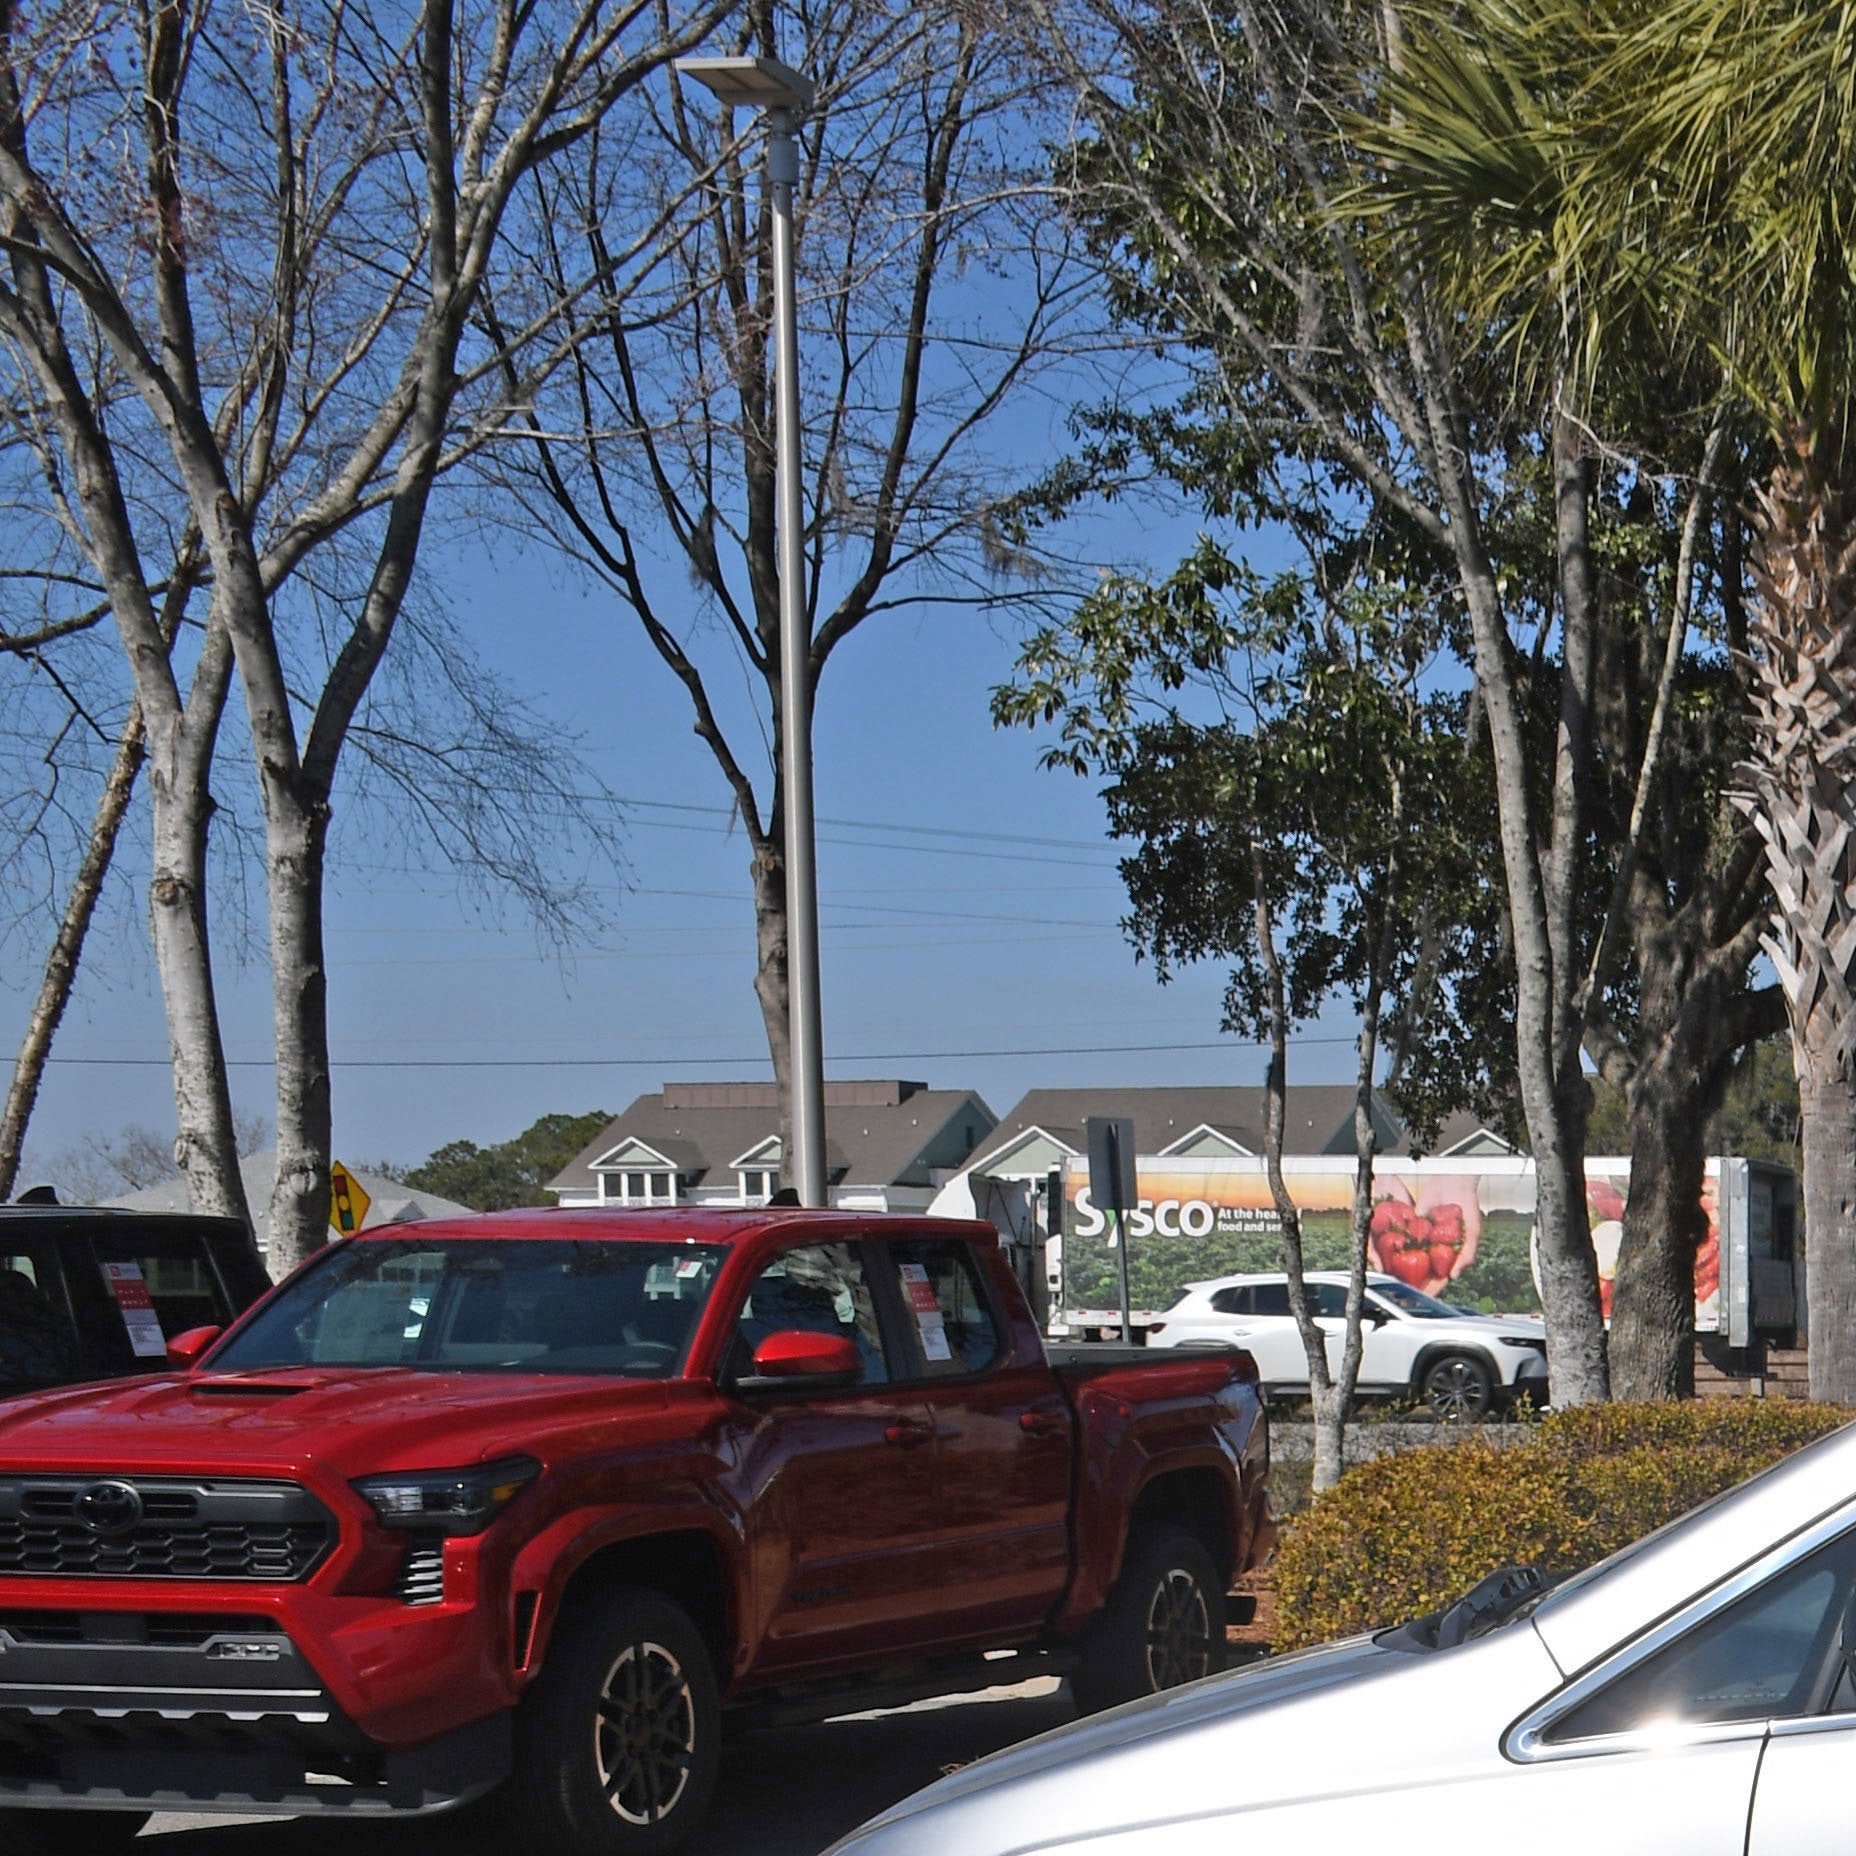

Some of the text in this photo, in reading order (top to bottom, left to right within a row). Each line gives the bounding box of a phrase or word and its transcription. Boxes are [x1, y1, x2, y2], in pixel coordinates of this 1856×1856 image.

[1217, 1207, 1232, 1220] At
[1233, 1207, 1253, 1220] the
[1217, 1221, 1243, 1232] food
[1243, 1221, 1265, 1232] and
